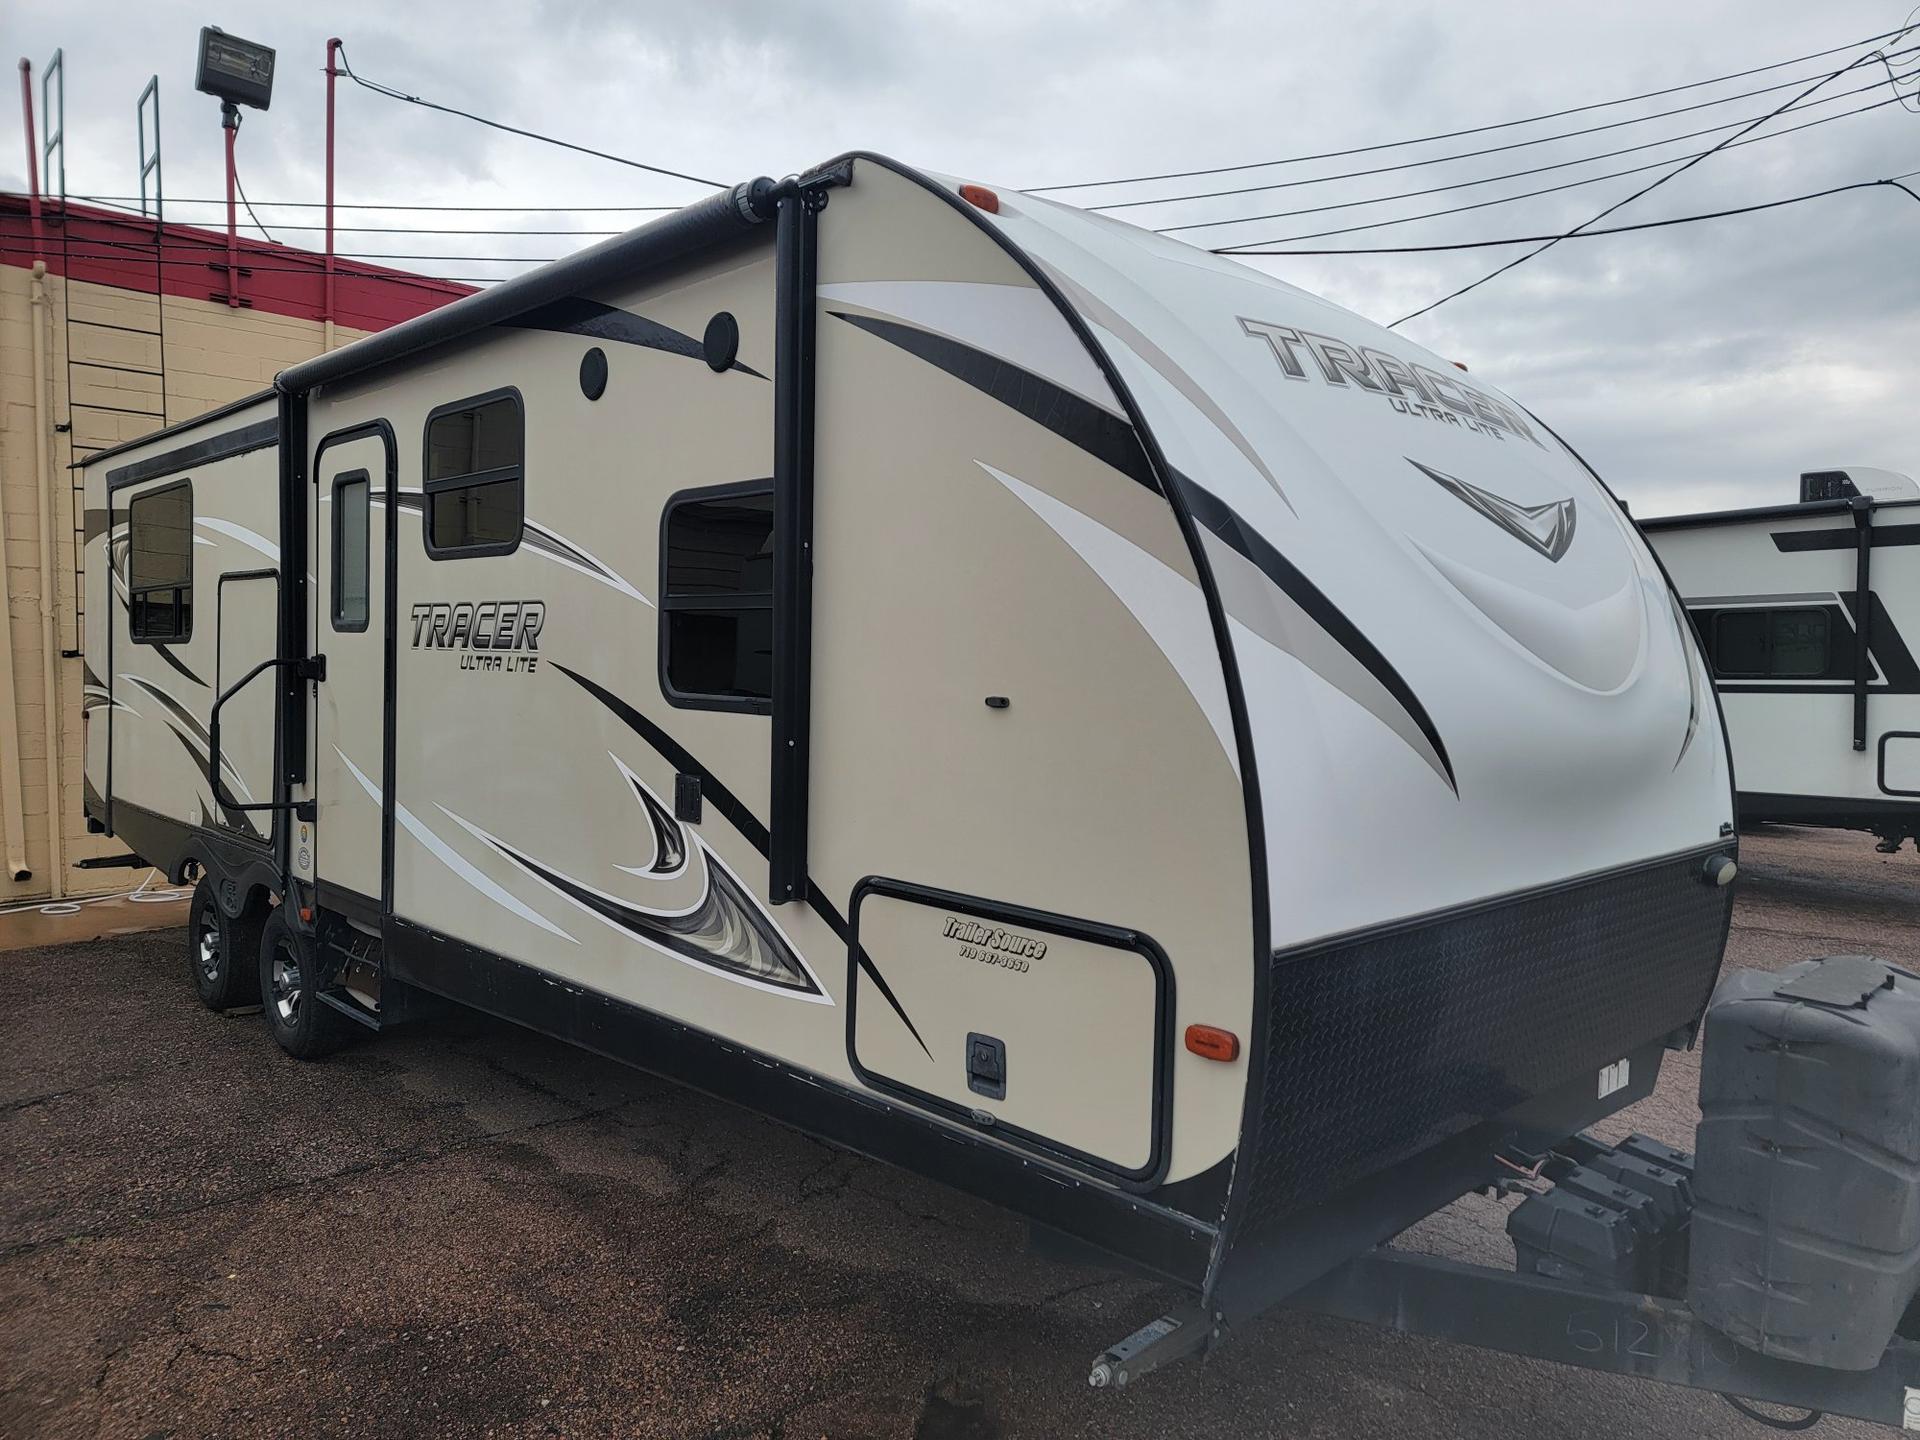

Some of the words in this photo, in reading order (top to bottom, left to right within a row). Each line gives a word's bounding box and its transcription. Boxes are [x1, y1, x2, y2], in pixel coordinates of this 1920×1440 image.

[1236, 315, 1550, 451] TRACER
[1388, 398, 1461, 427] ULTRA
[1466, 416, 1505, 441] LITE
[411, 600, 546, 653] TRACER
[460, 655, 501, 671] ULTRA
[506, 656, 538, 673] LITE
[943, 917, 991, 946] Trailer
[992, 928, 1047, 960] Source
[959, 945, 977, 960] 719
[1566, 1311, 1659, 1358] 512
